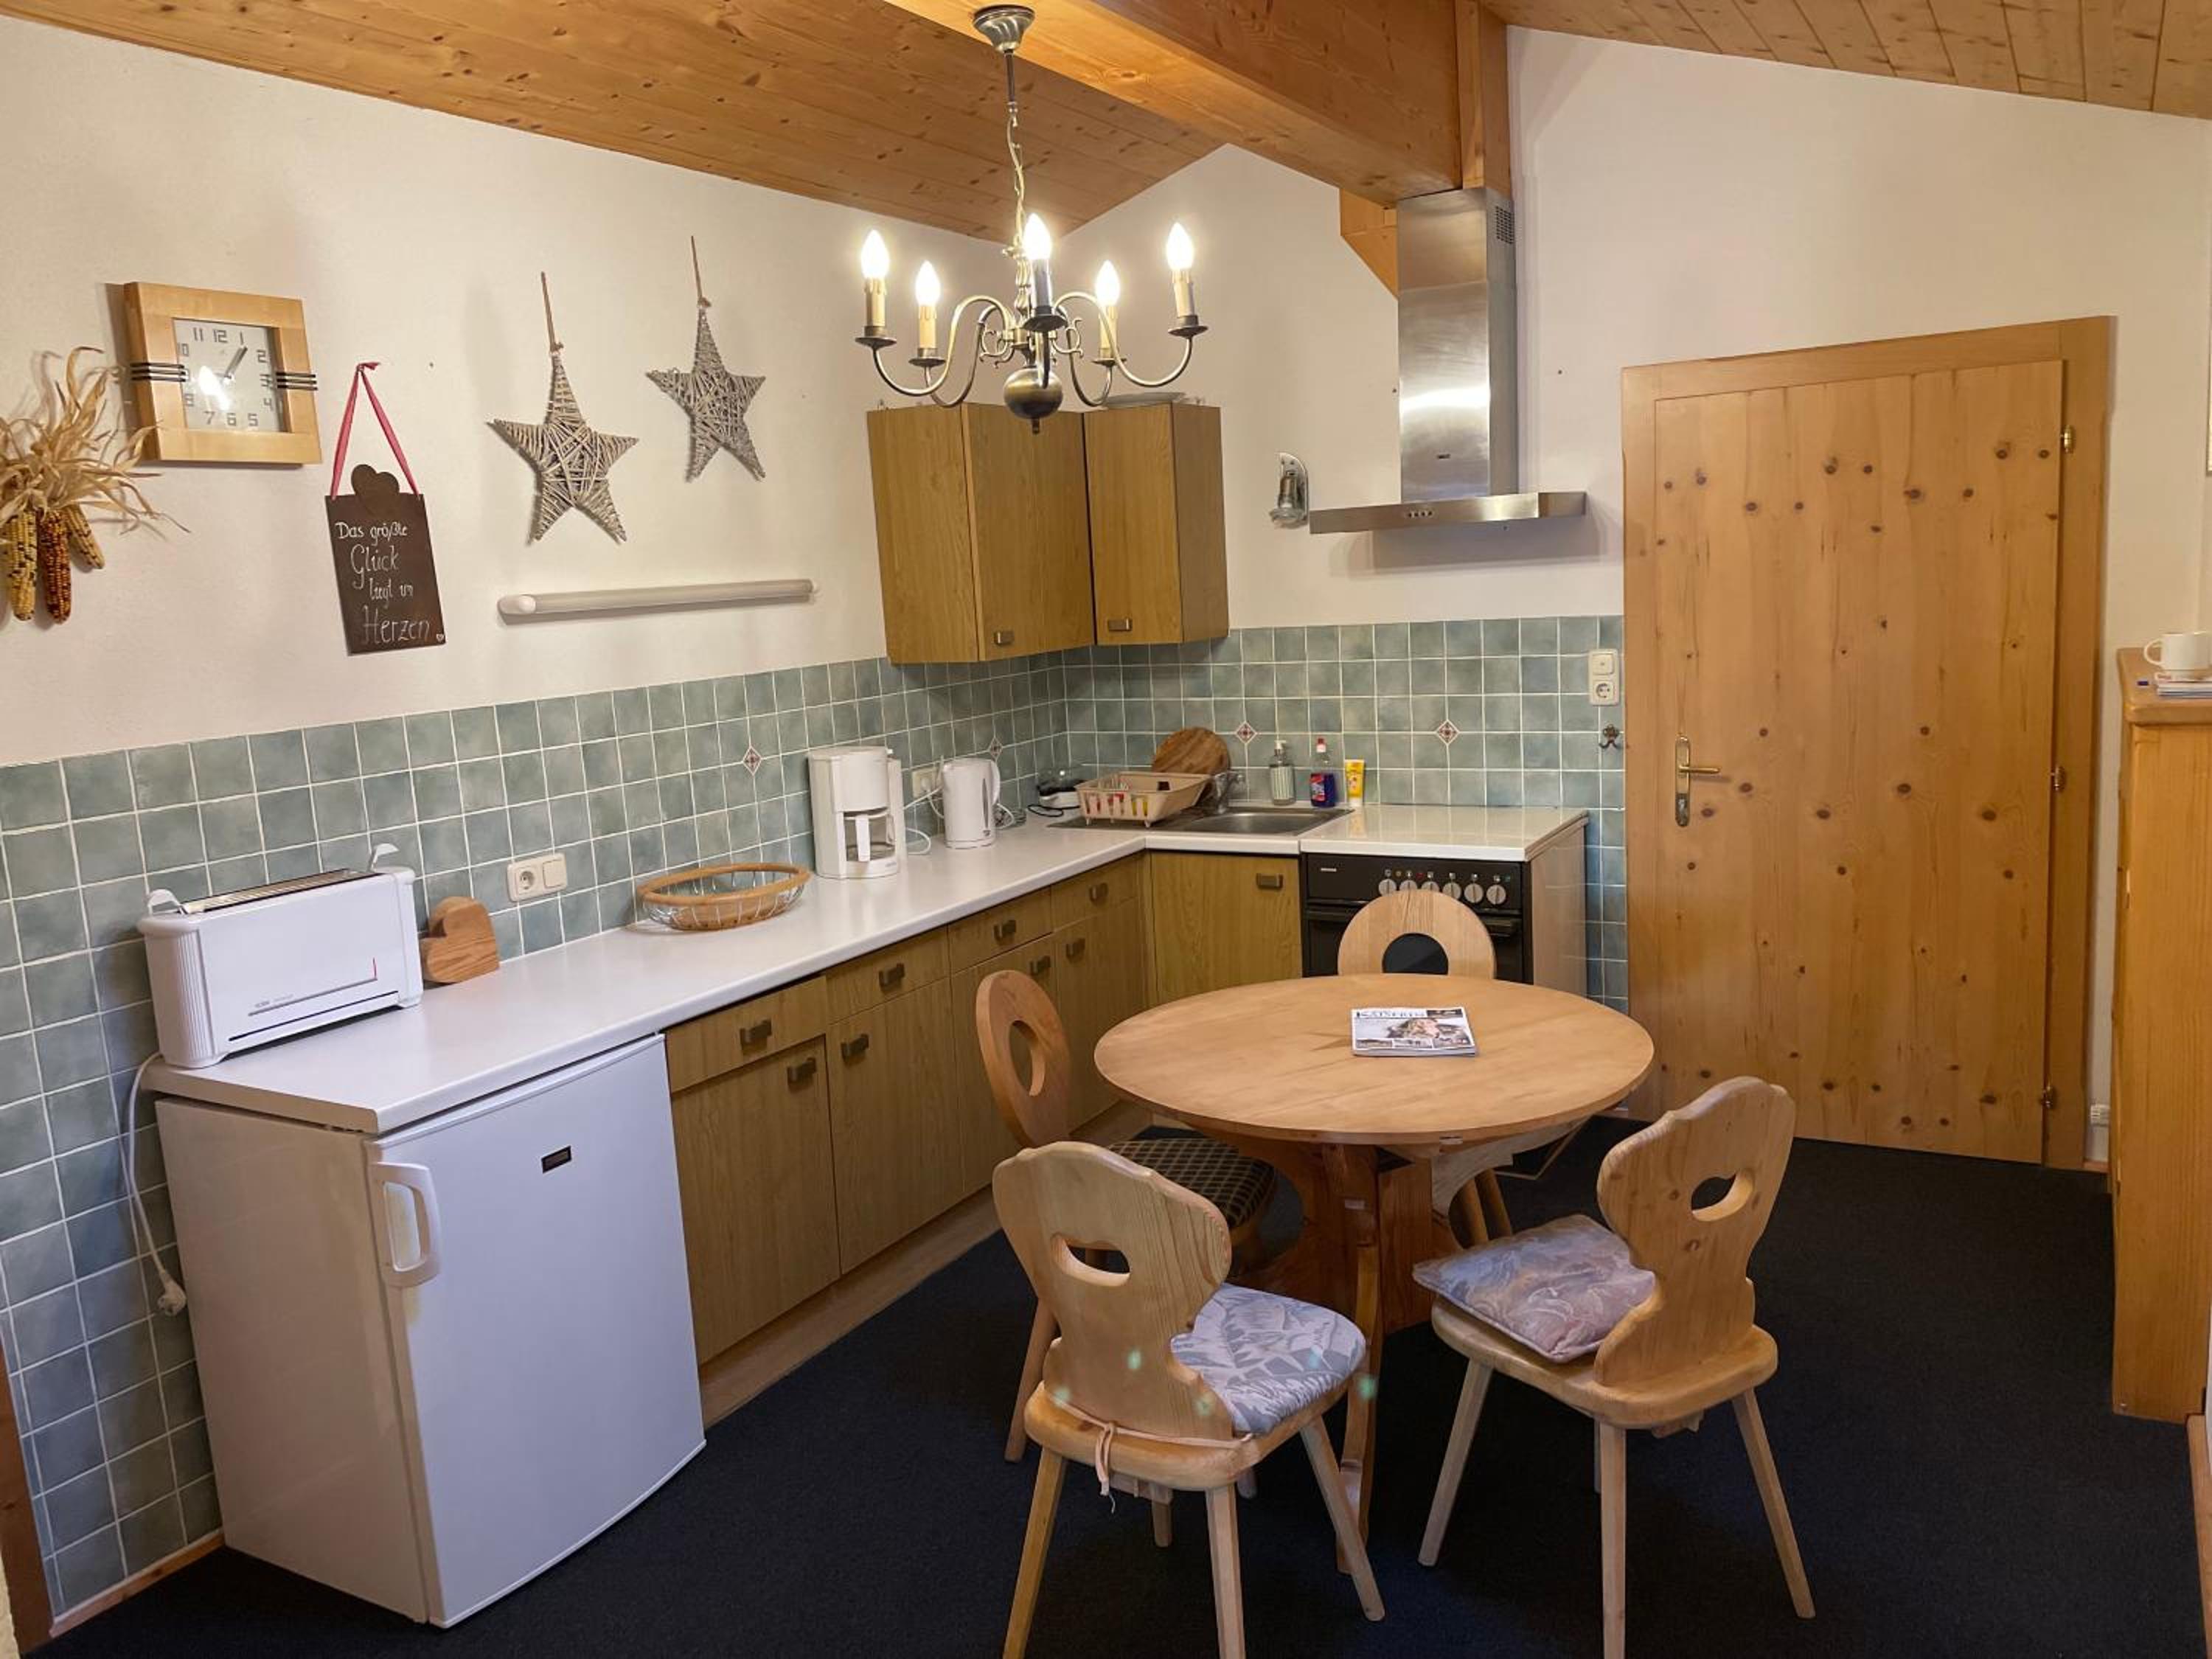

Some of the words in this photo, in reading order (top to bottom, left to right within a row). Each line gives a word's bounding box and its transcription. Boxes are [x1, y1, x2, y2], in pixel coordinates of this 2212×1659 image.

[192, 327, 204, 342] 11
[213, 329, 228, 344] 12
[240, 332, 245, 346] 1
[178, 343, 190, 358] 10
[255, 349, 267, 363] 2
[260, 374, 272, 388] 3
[184, 394, 194, 407] 8
[263, 398, 274, 412] 4
[204, 411, 215, 425] 7
[226, 413, 237, 426] 6
[247, 413, 259, 426] 5
[335, 521, 364, 539] Das
[349, 543, 400, 590] Glück
[362, 605, 431, 644] Herzen
